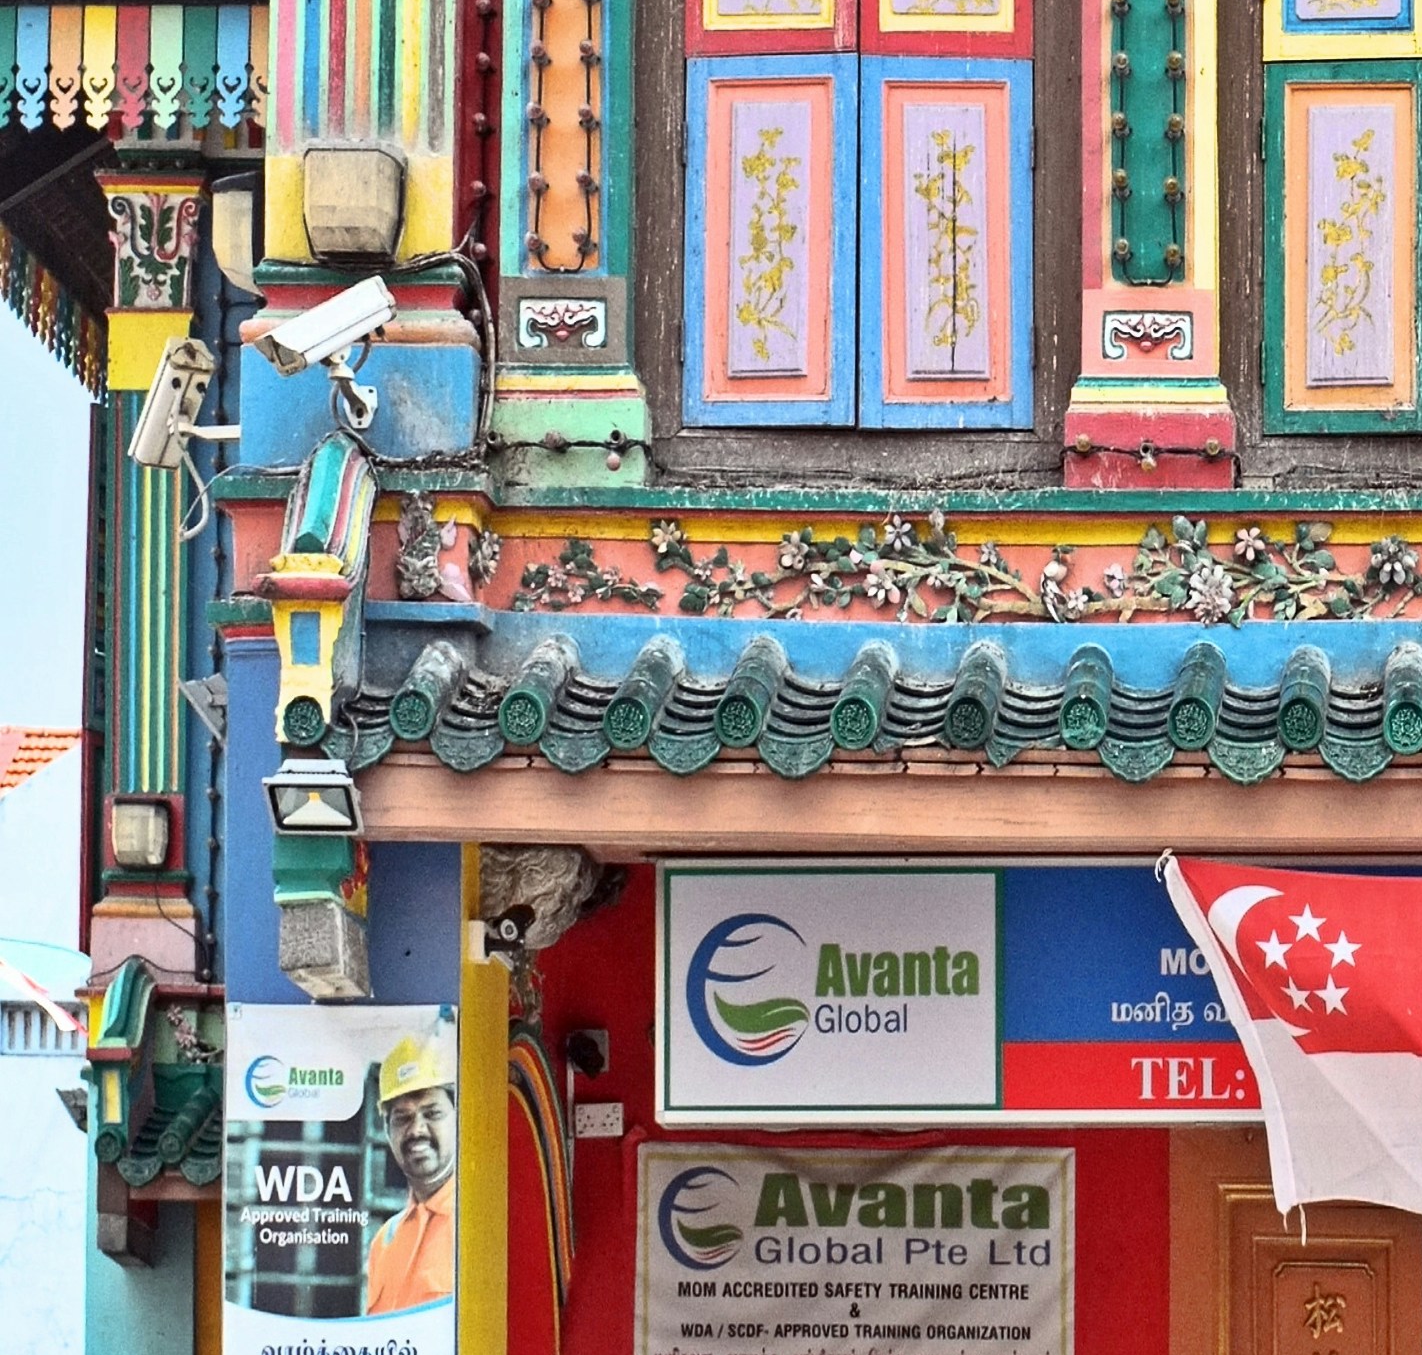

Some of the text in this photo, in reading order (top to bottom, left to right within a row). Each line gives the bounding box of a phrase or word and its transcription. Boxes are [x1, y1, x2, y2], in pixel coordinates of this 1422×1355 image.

[816, 943, 979, 997] Avanta
[1160, 947, 1211, 976] MO
[815, 1004, 907, 1033] Global
[289, 1067, 343, 1085] Avanta
[1132, 1057, 1246, 1100] TEL:
[288, 1087, 319, 1099] Global
[255, 1166, 352, 1202] WDA
[754, 1173, 1050, 1229] Avanta
[241, 1207, 369, 1227] Approved Training
[260, 1228, 349, 1246] Organisation
[755, 1236, 1050, 1266] Global Pte Ltd
[678, 1282, 1029, 1300] MOM ACCREDITED SAFETY TRAINING CENTRE
[849, 1302, 860, 1318] &
[681, 1324, 713, 1337] WDA
[774, 1324, 849, 1338] APPROVED
[855, 1324, 921, 1339] TRAINING
[927, 1325, 1031, 1340] ORGANIZATION
